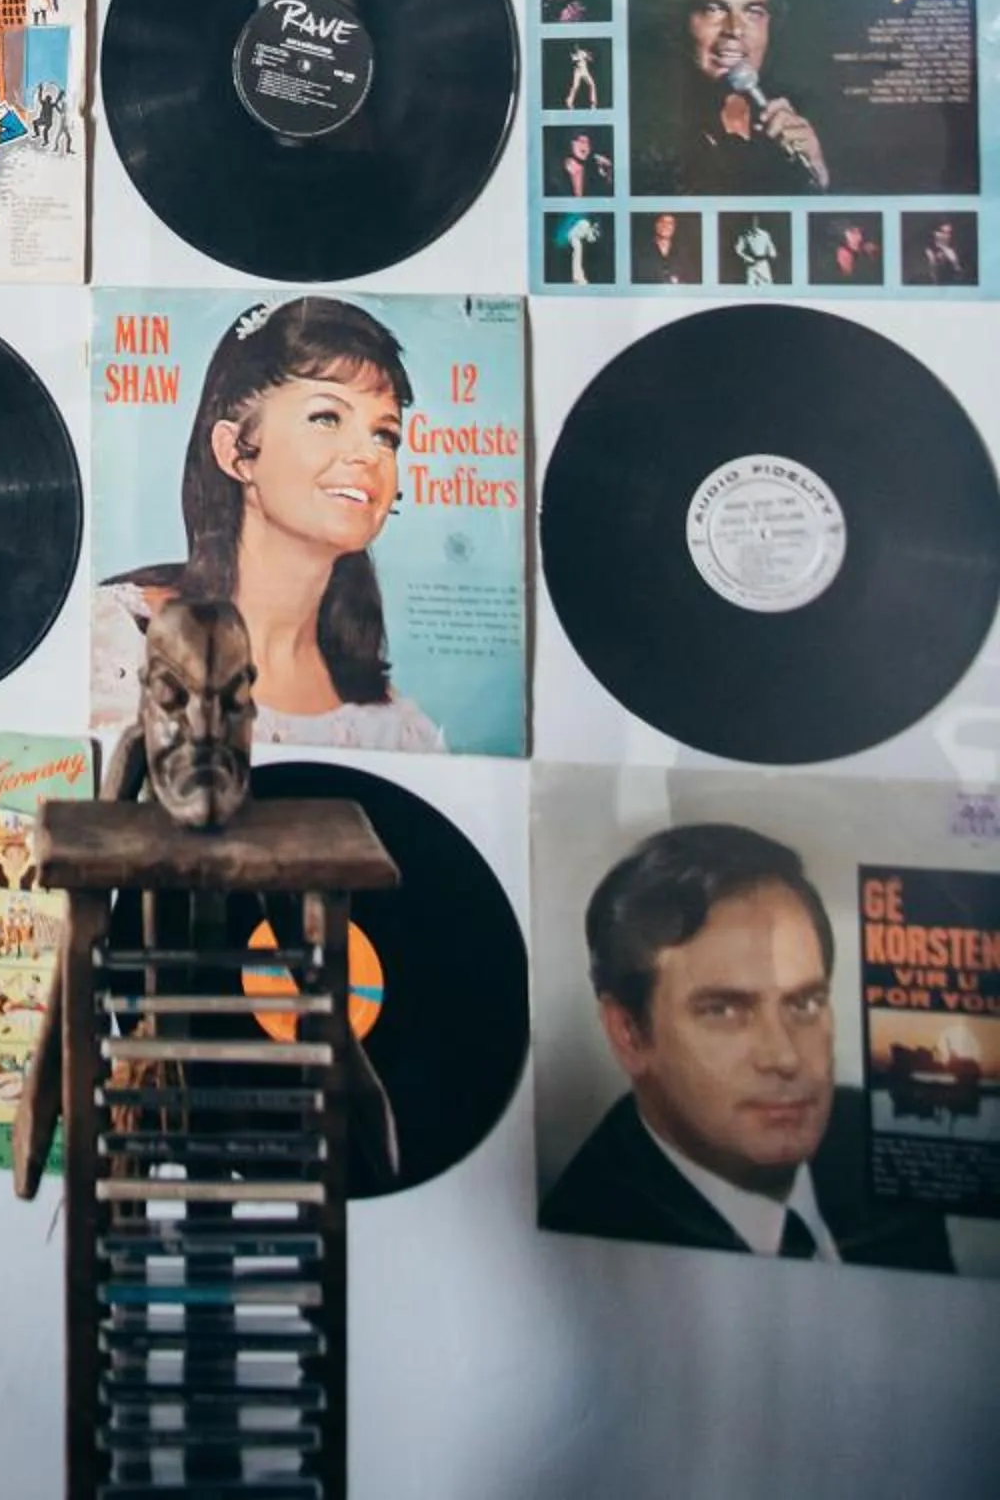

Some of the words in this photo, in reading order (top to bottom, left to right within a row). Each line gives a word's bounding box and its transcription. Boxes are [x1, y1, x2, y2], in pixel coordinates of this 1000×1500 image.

[274, 0, 360, 44] RAVE
[114, 314, 170, 356] MIN
[104, 365, 181, 405] SHAW
[451, 363, 478, 404] 12
[408, 413, 519, 457] Grootste
[408, 466, 518, 509] Treffers
[694, 470, 740, 525] AUDIO
[752, 464, 834, 514] FIDELITY
[865, 922, 1000, 971] KORSTEN
[866, 986, 931, 1008] FOR
[941, 991, 1000, 1013] YOU
[894, 967, 947, 987] VIR
[957, 970, 980, 991] U
